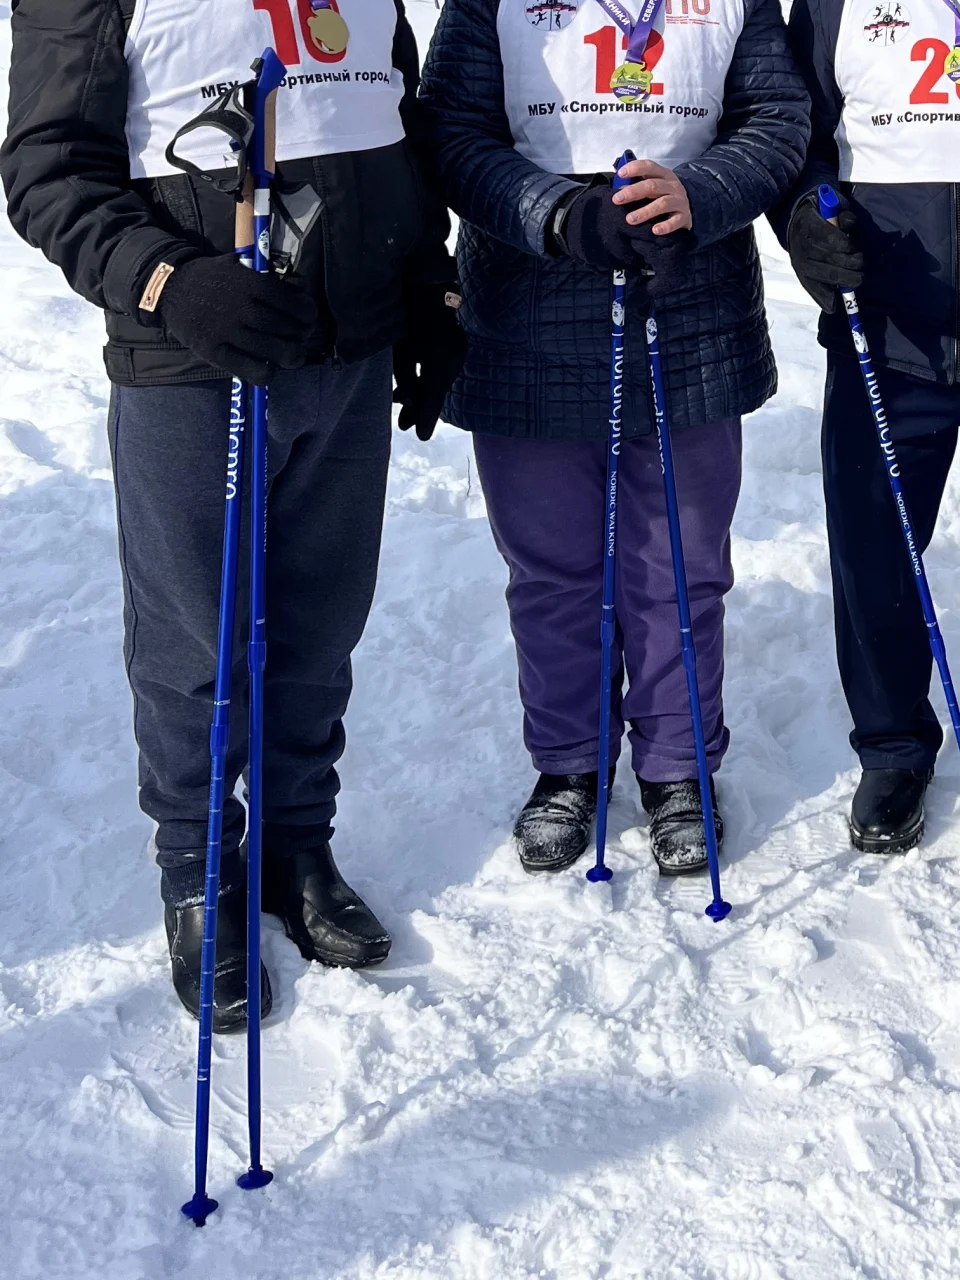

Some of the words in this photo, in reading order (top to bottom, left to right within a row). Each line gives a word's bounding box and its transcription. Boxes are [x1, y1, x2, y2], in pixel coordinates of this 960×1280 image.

[583, 25, 665, 96] 12
[527, 102, 556, 117] МБУ
[560, 100, 665, 117] «Спортивный
[871, 113, 893, 127] МБУ
[609, 470, 617, 509] NORDIC
[607, 510, 616, 557] WALKING
[895, 491, 910, 530] NORDIC
[906, 530, 922, 576] WALKING
